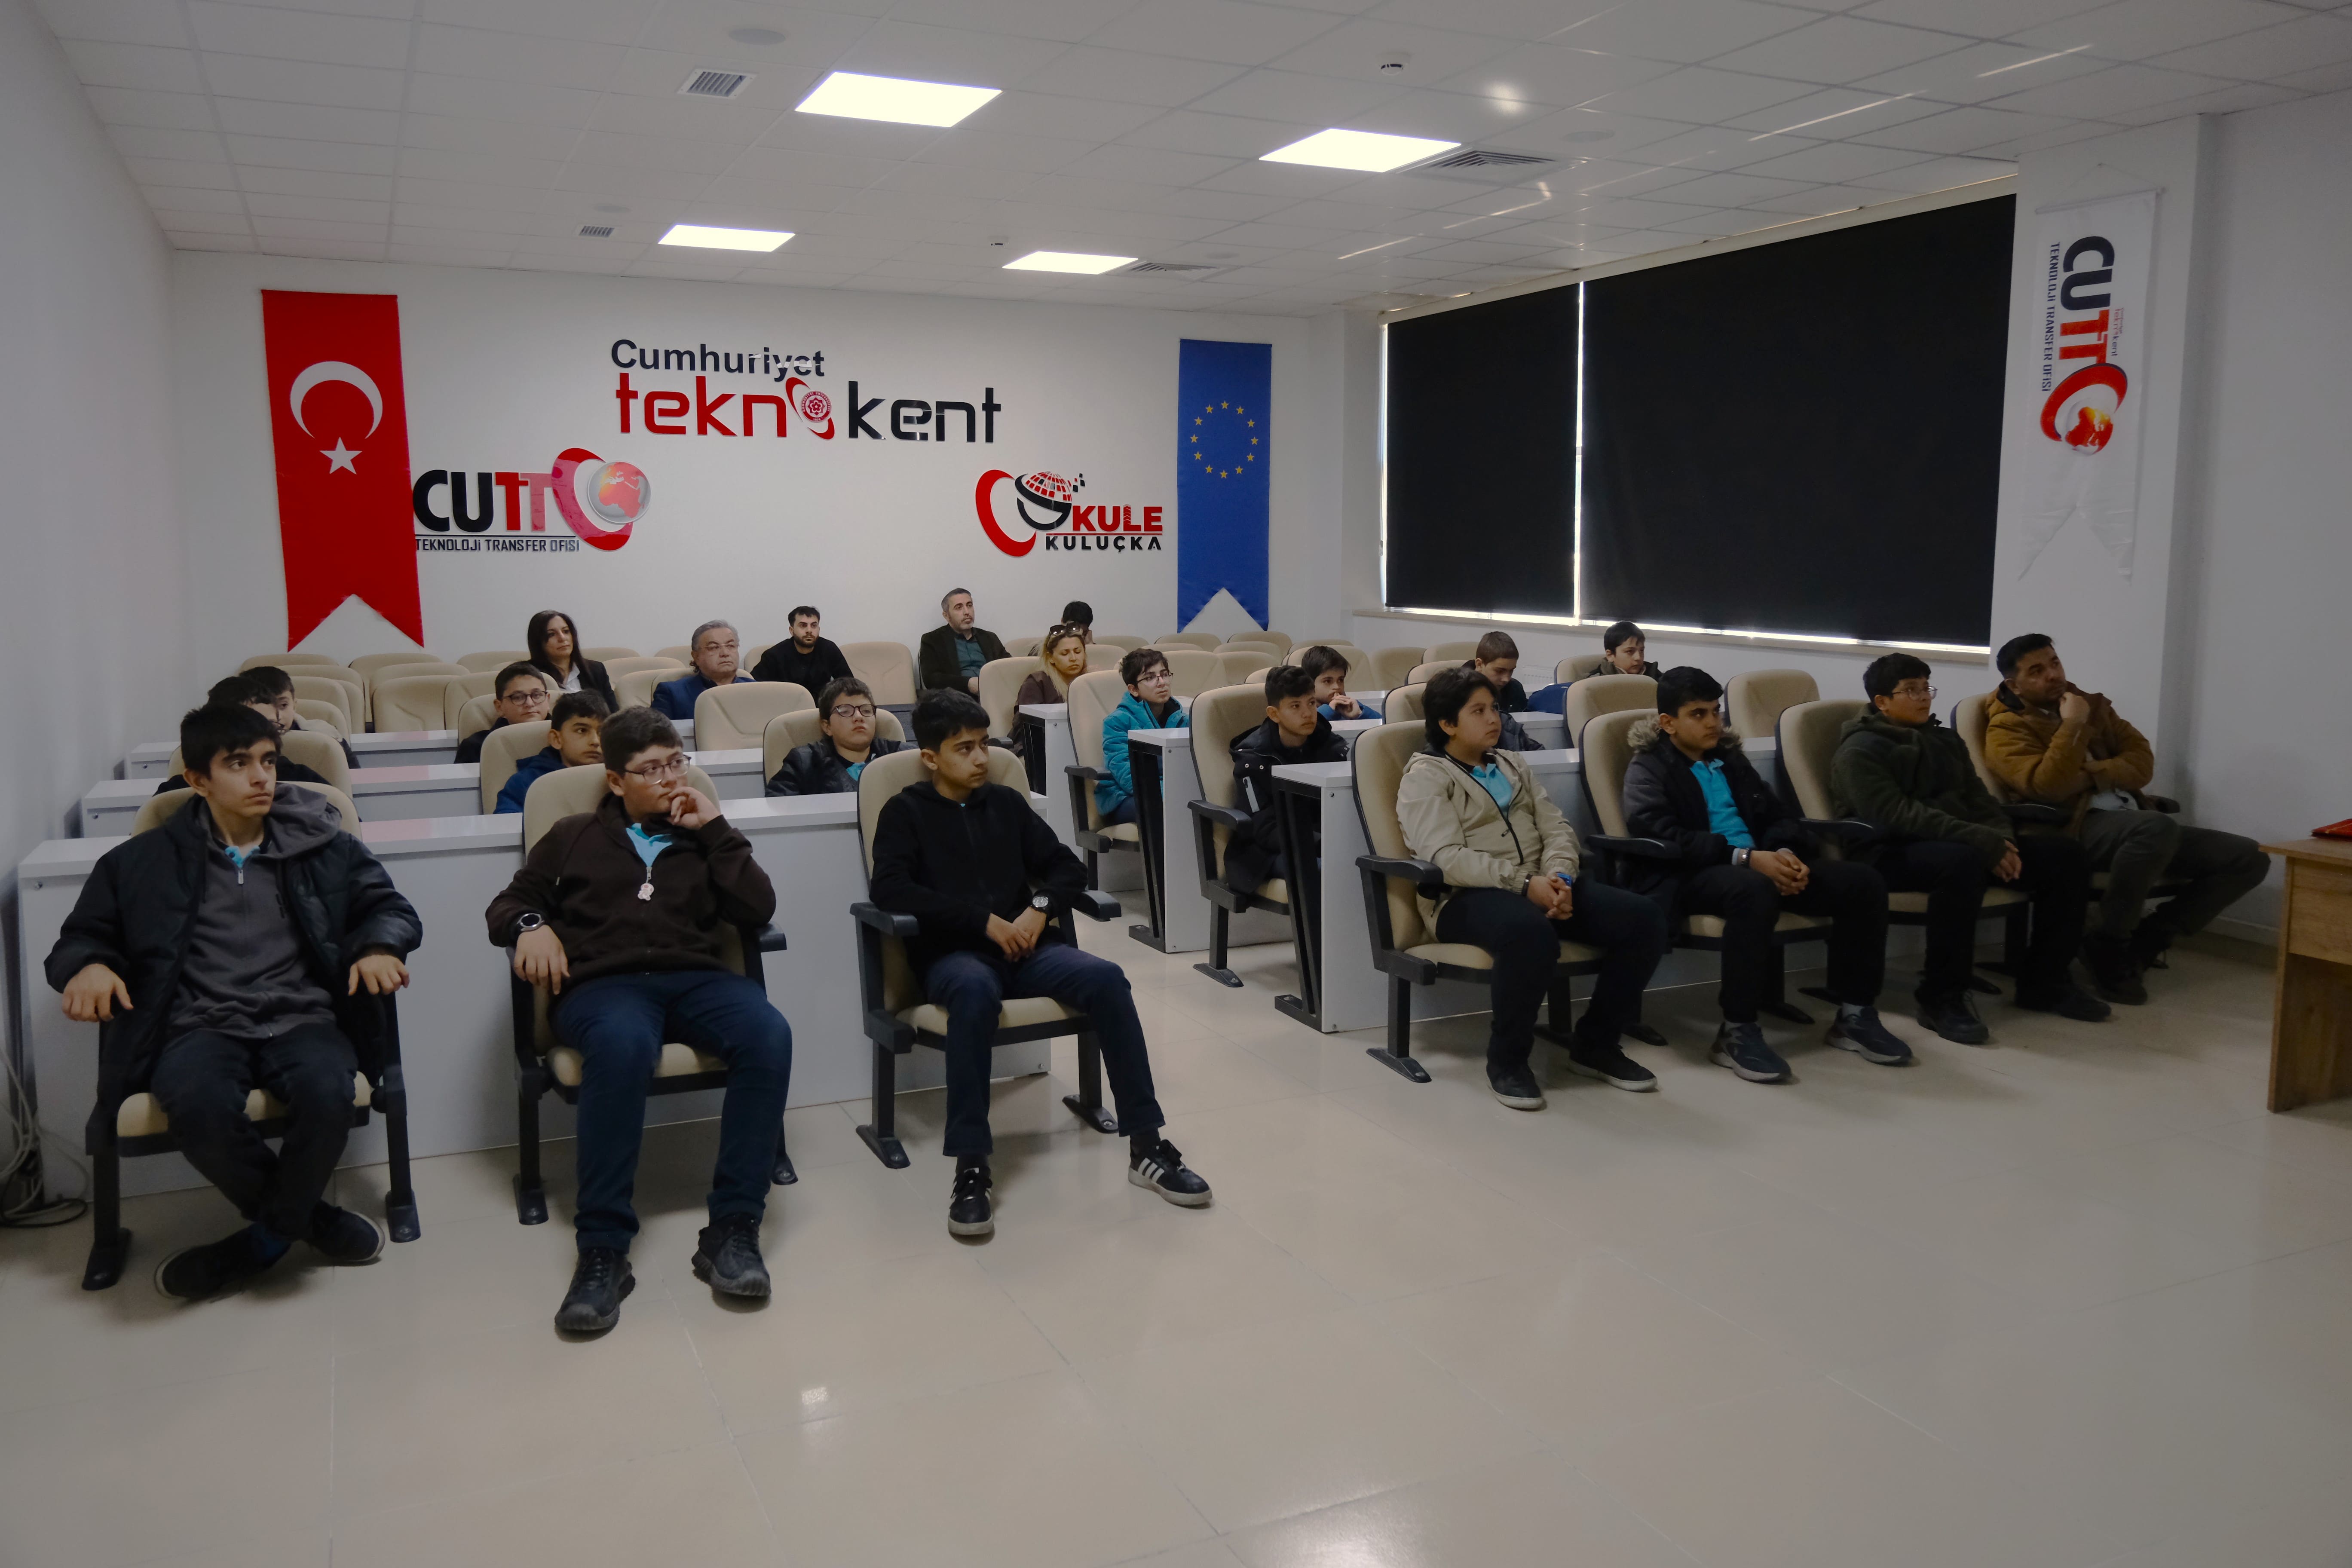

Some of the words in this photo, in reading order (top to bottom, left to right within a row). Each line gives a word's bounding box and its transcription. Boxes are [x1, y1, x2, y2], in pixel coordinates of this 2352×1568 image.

[2043, 304, 2055, 361] TRANSFER
[611, 339, 825, 382] Cumhuriyet
[485, 539, 546, 551] TRANSFER
[1046, 536, 1162, 552] KULUÇKA
